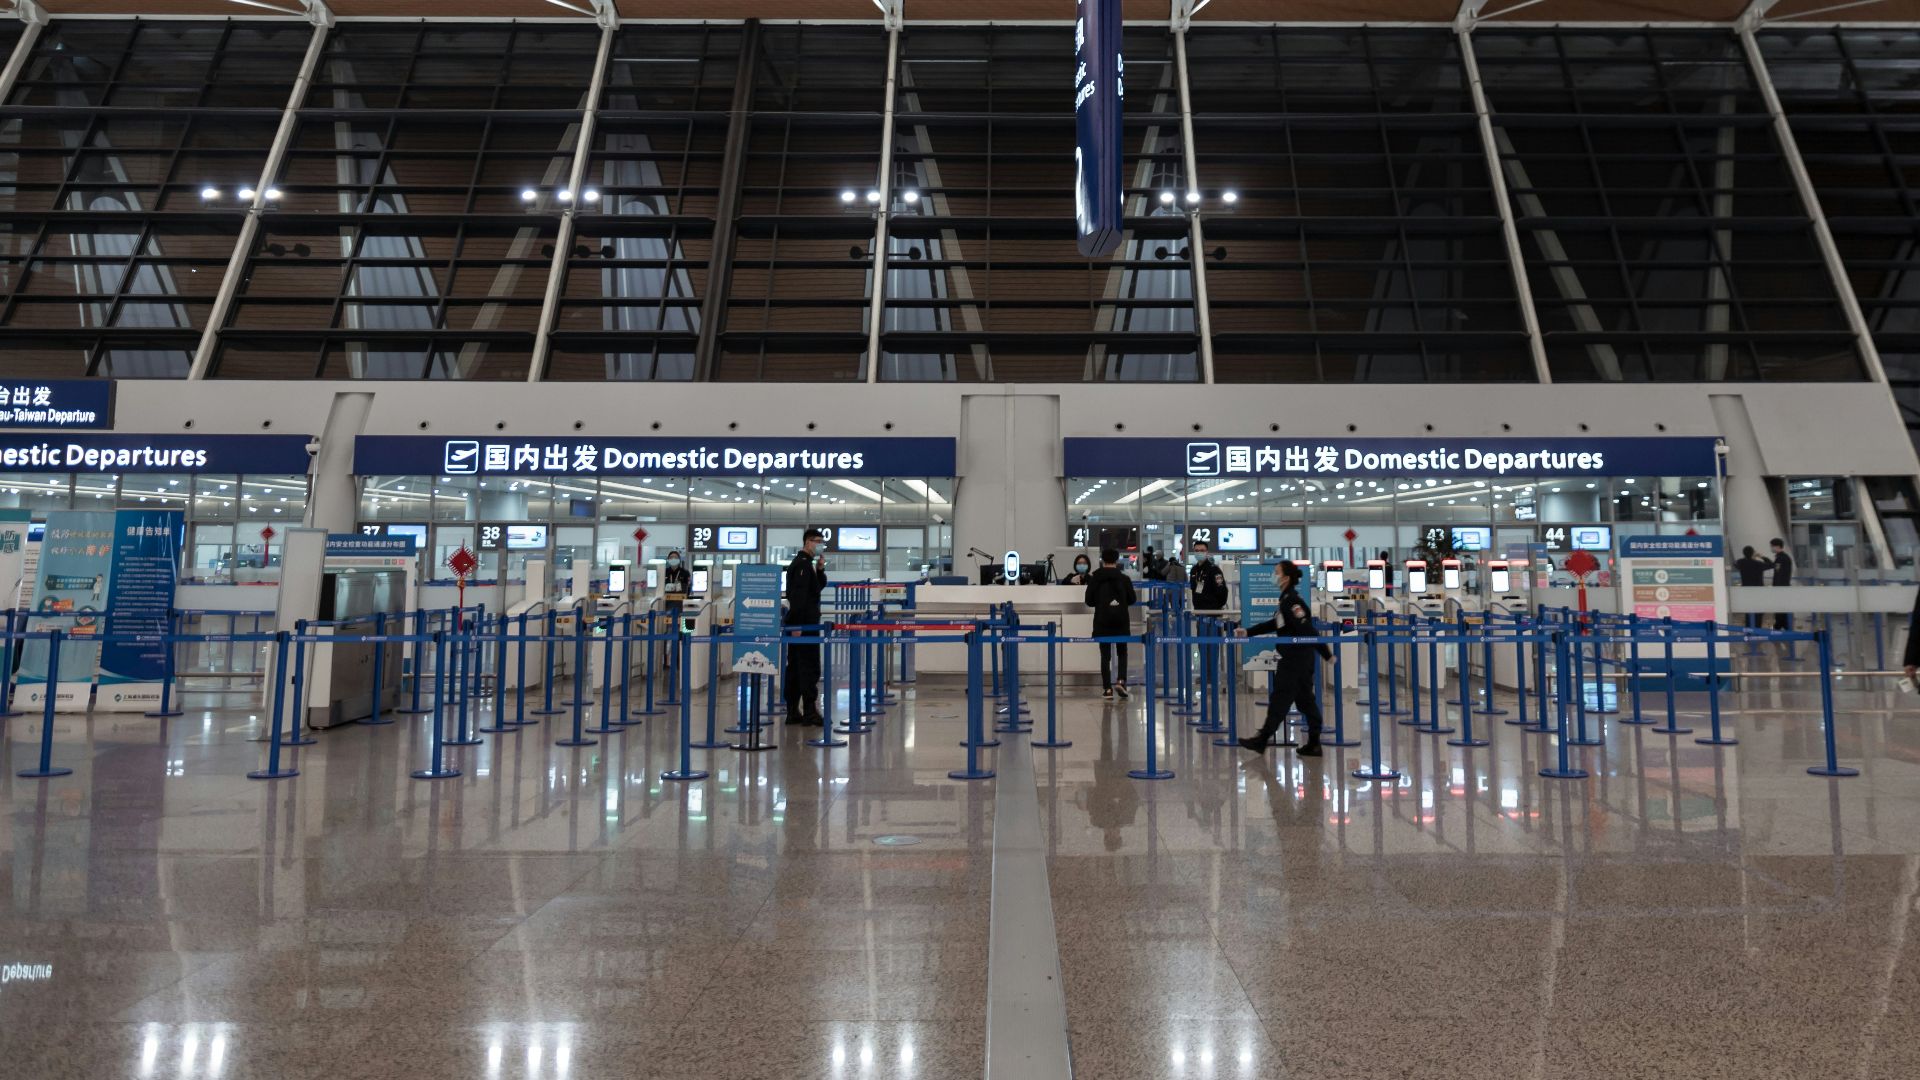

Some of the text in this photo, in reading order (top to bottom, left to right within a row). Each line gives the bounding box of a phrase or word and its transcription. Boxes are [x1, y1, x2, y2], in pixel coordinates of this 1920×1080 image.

[0, 386, 51, 406] 台出发
[48, 409, 95, 424] Departure
[0, 444, 206, 470] estic Departures
[485, 444, 863, 473] 国内出发 Domestic Departures
[1226, 446, 1603, 474] 国内出发 Domestic Departures
[362, 525, 380, 536] 37
[482, 526, 500, 540] 38
[693, 527, 712, 541] 39
[1192, 528, 1211, 542] 42
[1545, 527, 1566, 541] 44
